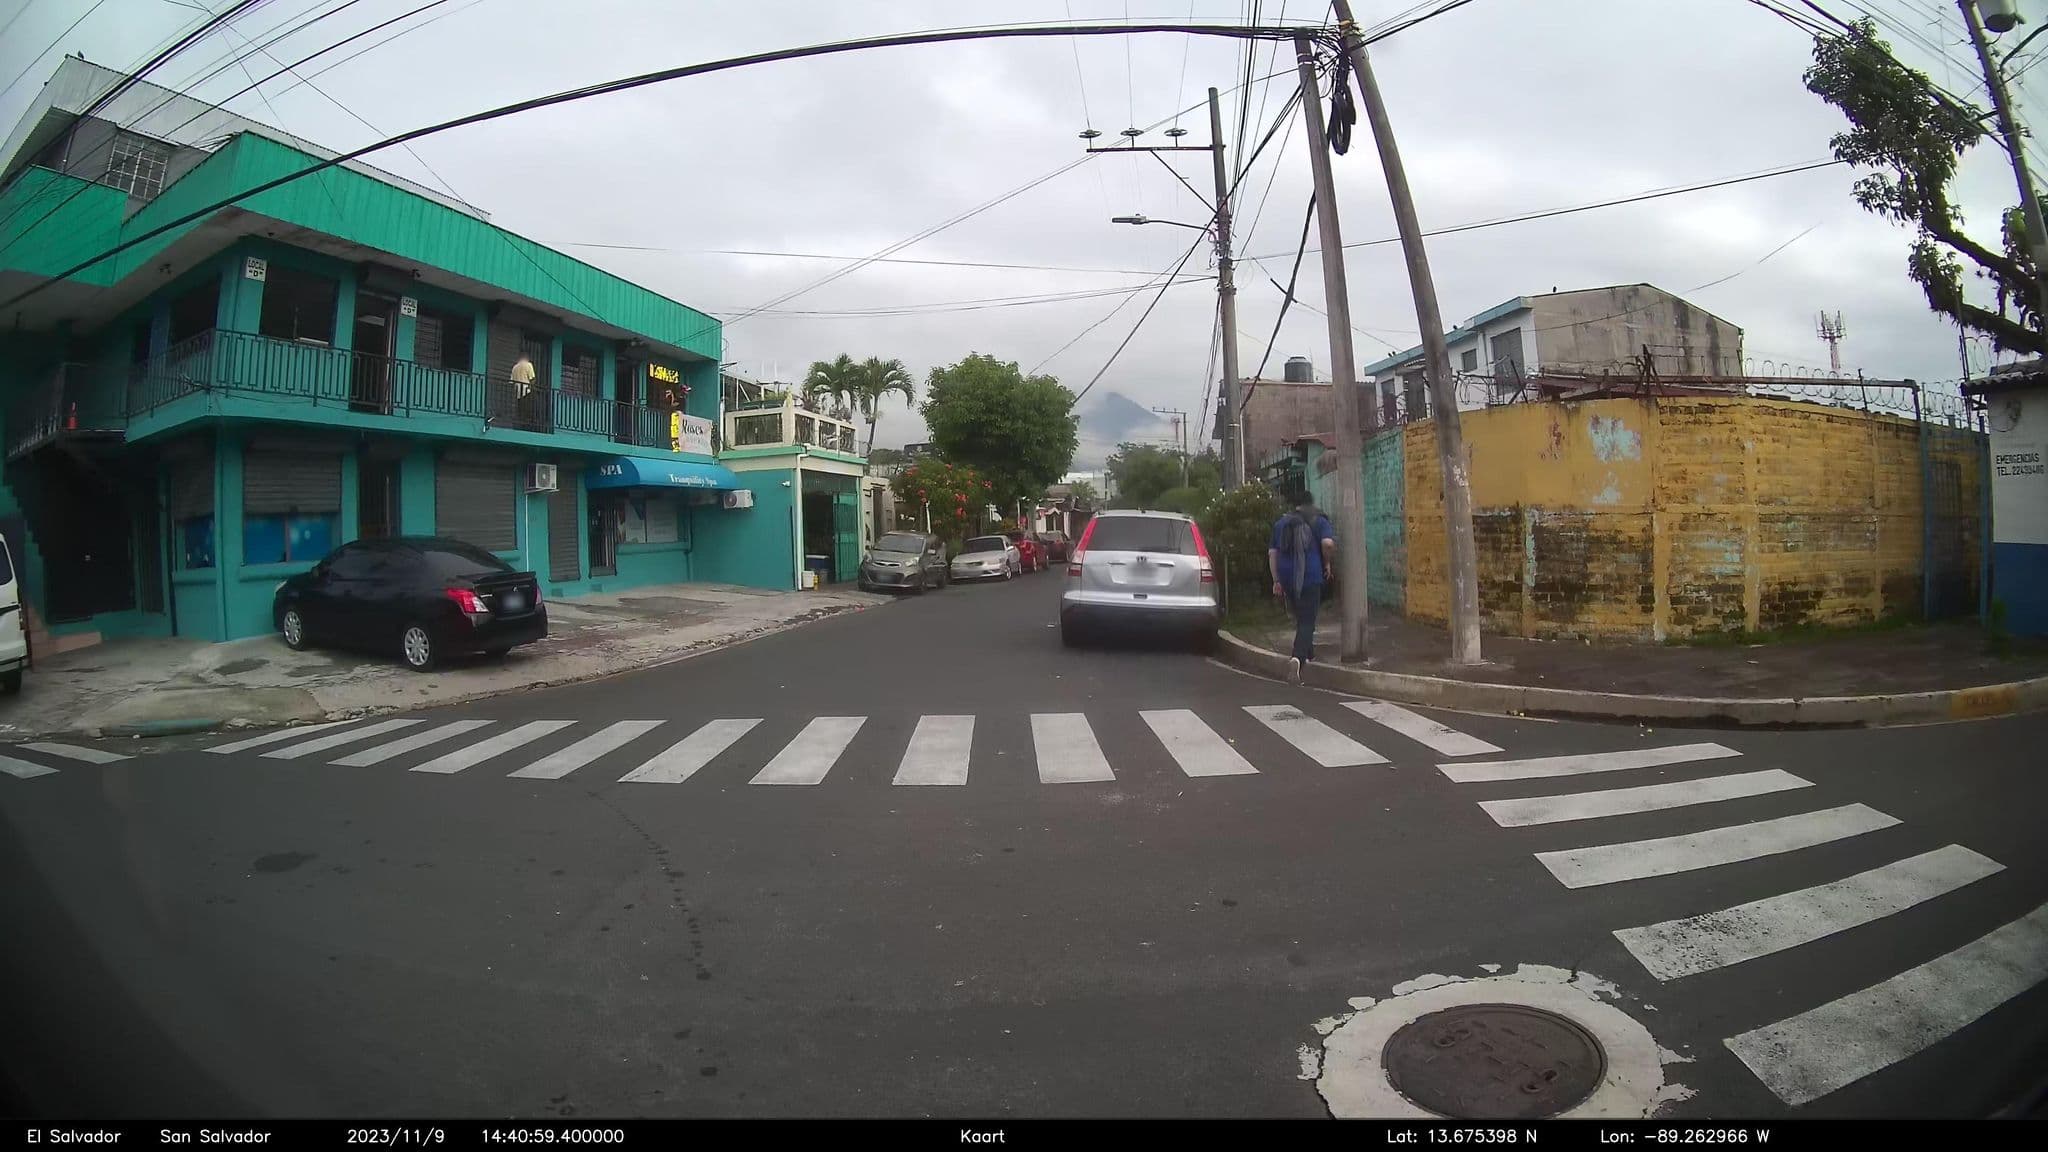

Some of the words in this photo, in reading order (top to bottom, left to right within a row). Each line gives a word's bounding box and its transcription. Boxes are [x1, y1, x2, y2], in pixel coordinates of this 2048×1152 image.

[248, 259, 265, 270] LOCAL
[1996, 453, 2039, 464] EMERGENCIAS
[600, 464, 623, 476] SPA
